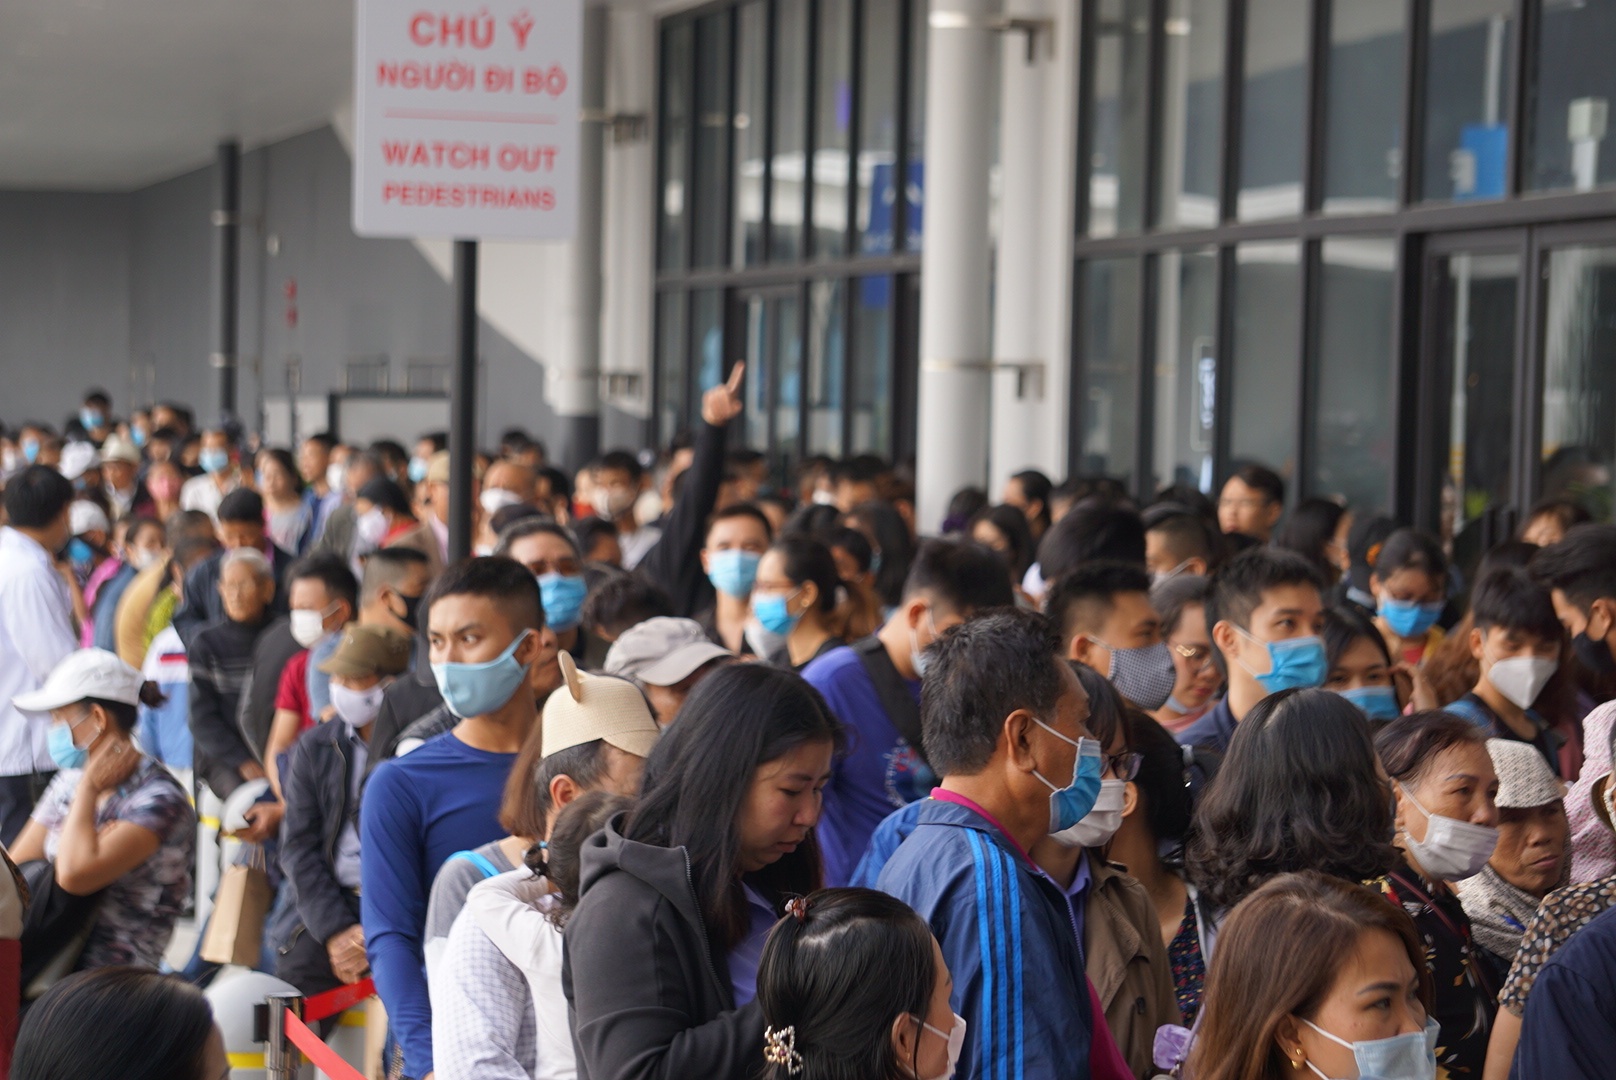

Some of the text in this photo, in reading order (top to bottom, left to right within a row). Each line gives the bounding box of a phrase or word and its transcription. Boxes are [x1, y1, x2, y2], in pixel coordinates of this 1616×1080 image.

[407, 7, 536, 51] CHÚ Ý
[482, 65, 515, 93] ĐI
[521, 64, 568, 99] BỘ
[381, 140, 559, 173] WATCH OUT
[381, 180, 557, 211] PEDESTRIANS
